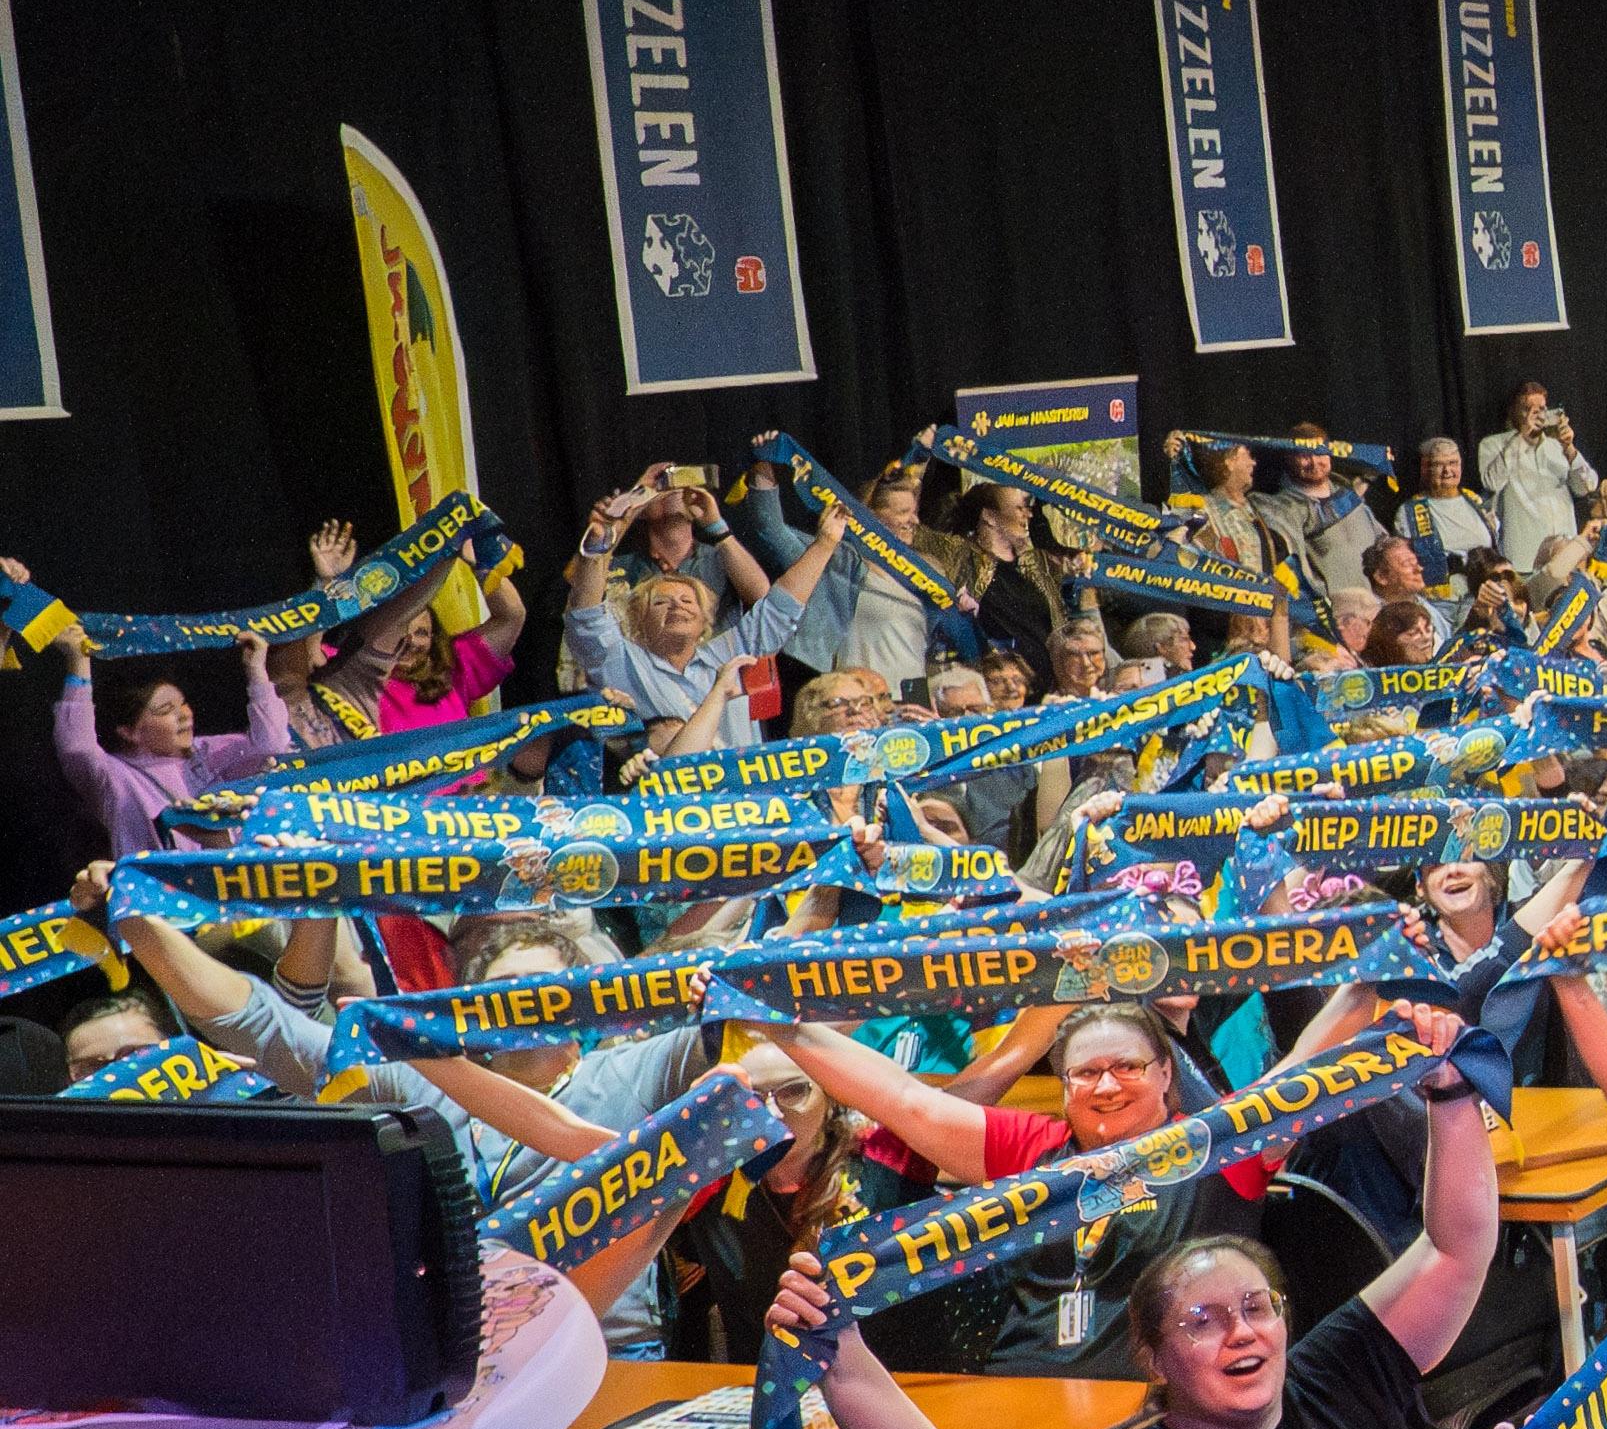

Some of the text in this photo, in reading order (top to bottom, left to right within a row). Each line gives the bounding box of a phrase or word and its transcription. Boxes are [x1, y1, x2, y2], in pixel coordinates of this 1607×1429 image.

[1030, 406, 1089, 426] HAASTEREN
[984, 453, 1161, 531] JAN VAN HAASTEREN
[402, 497, 486, 567] HOERA
[862, 531, 954, 610] HAASTEREN
[1106, 564, 1144, 584] JAN
[1074, 657, 1250, 740] HAASTEREN
[425, 797, 521, 838] HIEP
[1125, 810, 1173, 841] JAN
[1369, 799, 1438, 844] HIEP
[214, 857, 481, 900] HIEP HIEP
[640, 841, 817, 882] HOERA
[1185, 924, 1357, 973] HOERA
[789, 950, 1036, 998] HIEP HIEP
[453, 991, 571, 1032] HIEP
[1224, 1029, 1431, 1136] HOERA
[528, 1130, 686, 1260] HOERA
[896, 1181, 1049, 1274] HIEP
